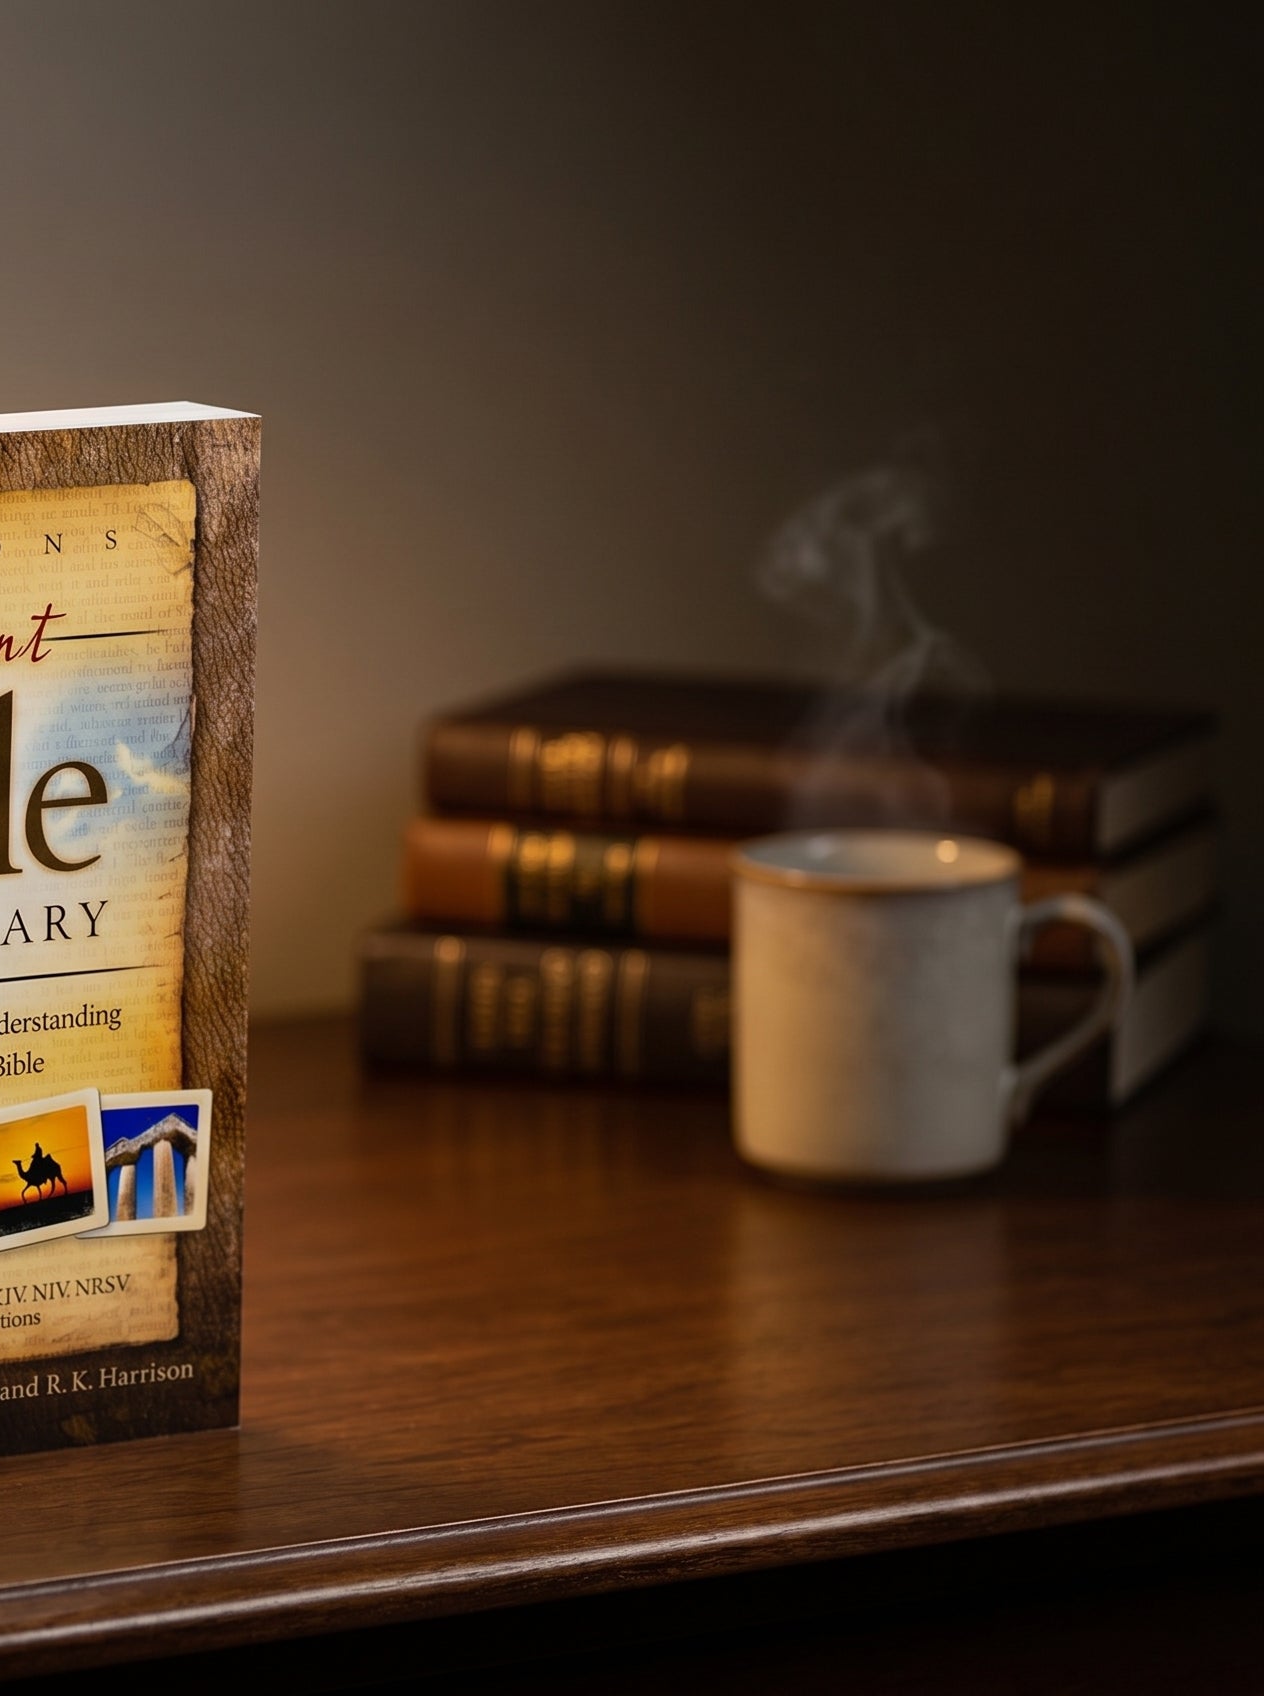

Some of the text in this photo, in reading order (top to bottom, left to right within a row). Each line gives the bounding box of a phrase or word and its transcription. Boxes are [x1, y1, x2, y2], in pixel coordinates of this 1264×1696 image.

[76, 1274, 130, 1296] NRSV
[0, 1376, 38, 1400] and
[48, 1375, 66, 1394] R.
[73, 1371, 92, 1391] K.
[99, 1363, 194, 1388] Harrison
